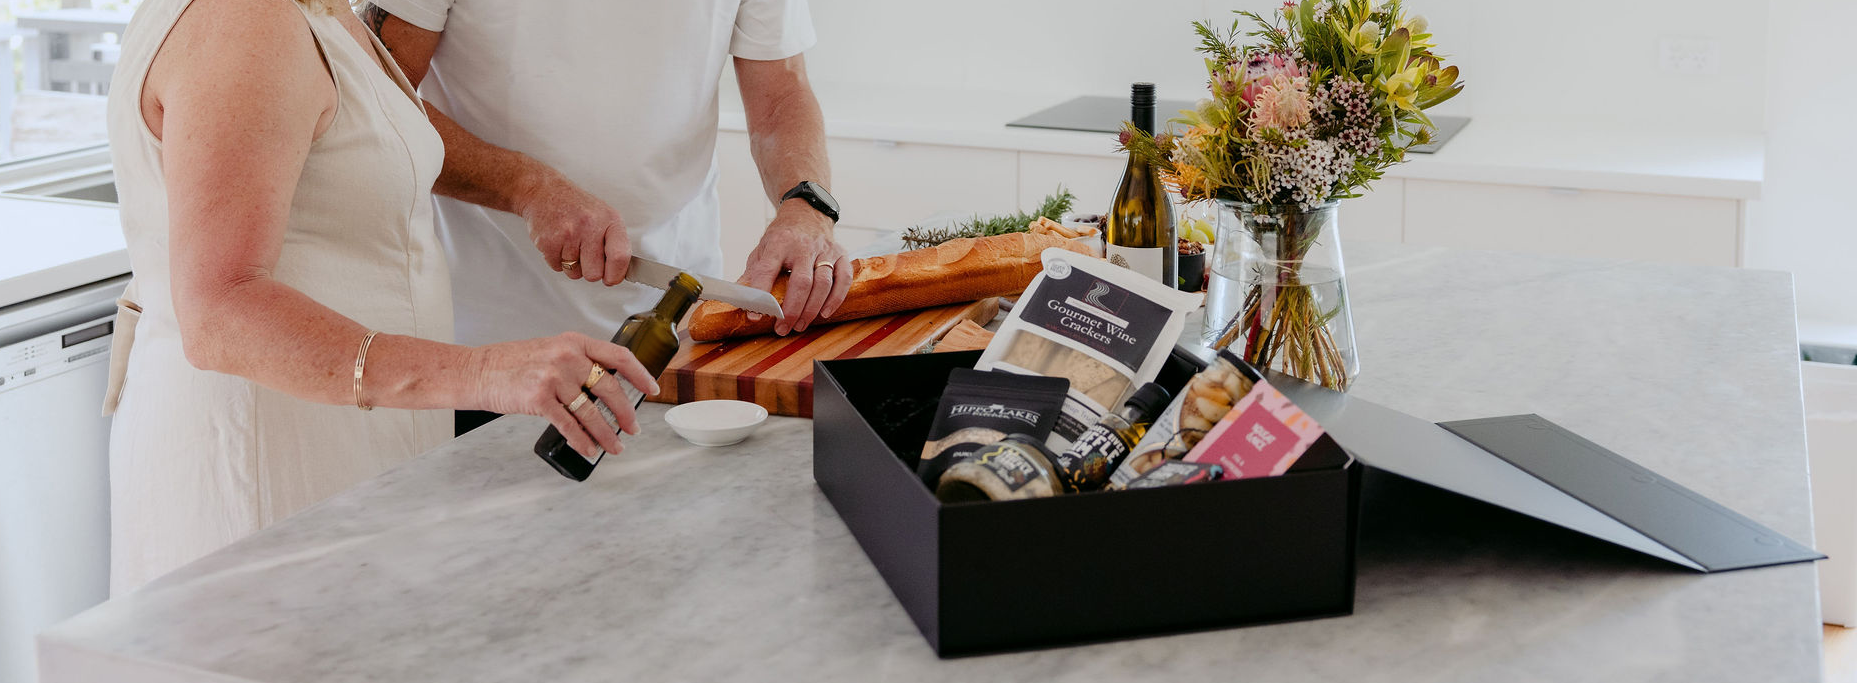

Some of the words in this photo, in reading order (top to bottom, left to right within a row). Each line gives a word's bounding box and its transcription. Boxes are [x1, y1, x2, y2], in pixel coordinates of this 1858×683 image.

[1047, 299, 1102, 329] Gourmet
[1105, 323, 1137, 345] Wine
[1060, 316, 1112, 345] Crackers
